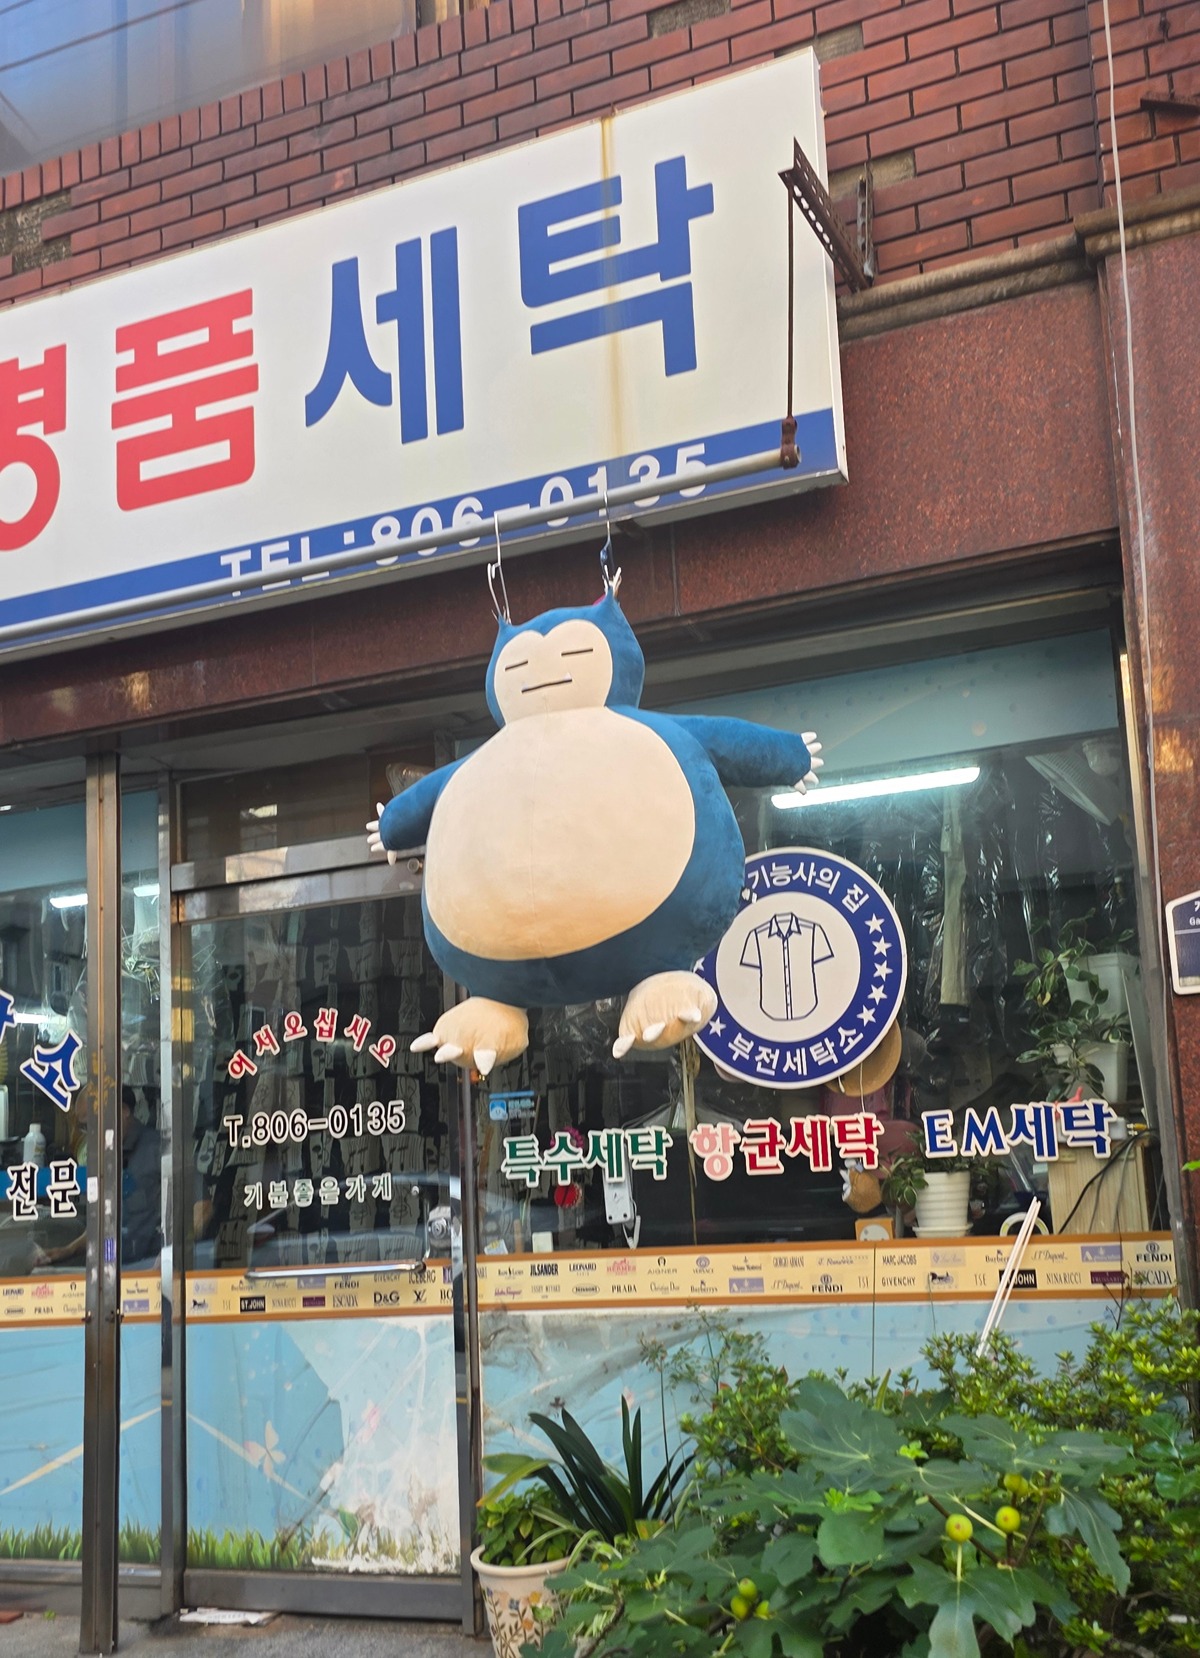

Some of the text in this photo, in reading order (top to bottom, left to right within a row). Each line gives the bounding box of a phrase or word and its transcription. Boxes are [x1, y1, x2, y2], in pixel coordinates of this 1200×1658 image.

[748, 862, 869, 914] 기능사의 집
[228, 1007, 396, 1079] 어서오십시오
[224, 1099, 407, 1149] T.806-0135
[500, 1098, 1118, 1188] 특수세탁 항균세탁 EM세탁
[7, 1157, 82, 1222] 전문
[882, 1254, 917, 1265] MARC JACOBS
[1136, 1253, 1172, 1262] FENDI
[569, 1263, 597, 1272] LEONARD
[334, 1281, 360, 1289] FENDI
[881, 1276, 917, 1287] GIVENCHY
[611, 1284, 638, 1294] PRADA
[812, 1284, 844, 1293] FENDI
[373, 1291, 400, 1303] D&G
